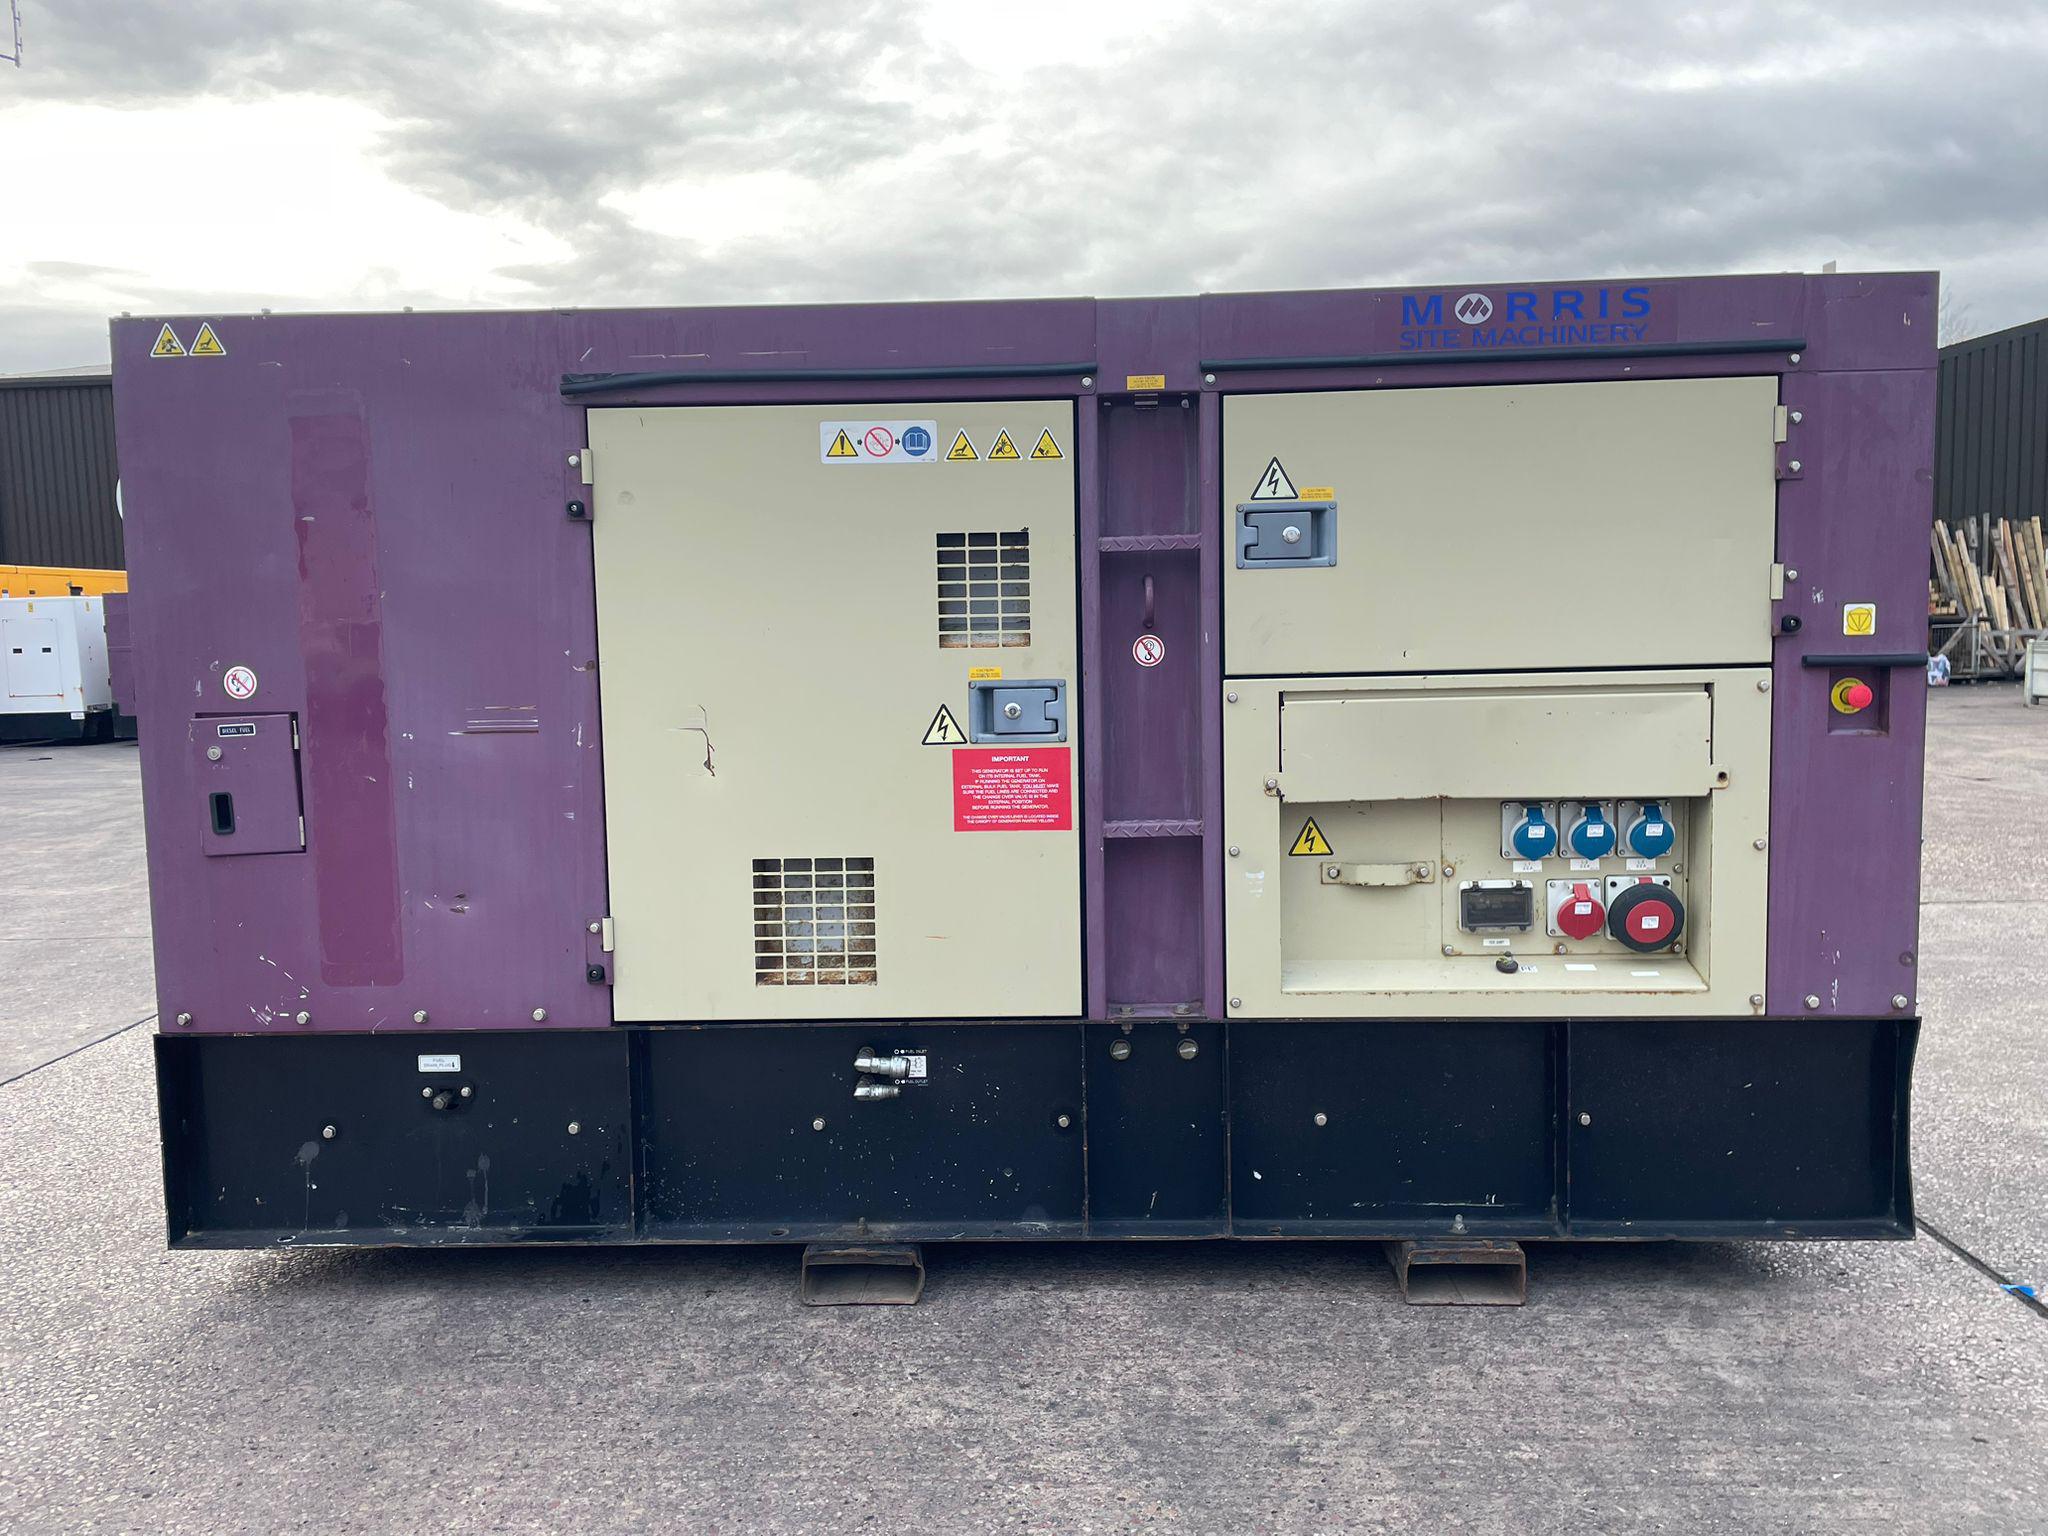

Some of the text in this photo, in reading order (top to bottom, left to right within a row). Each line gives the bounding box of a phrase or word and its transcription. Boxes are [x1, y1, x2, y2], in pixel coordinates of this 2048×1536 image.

[1402, 286, 1651, 326] MORRIS
[1400, 323, 1649, 350] SITE MACHINERY
